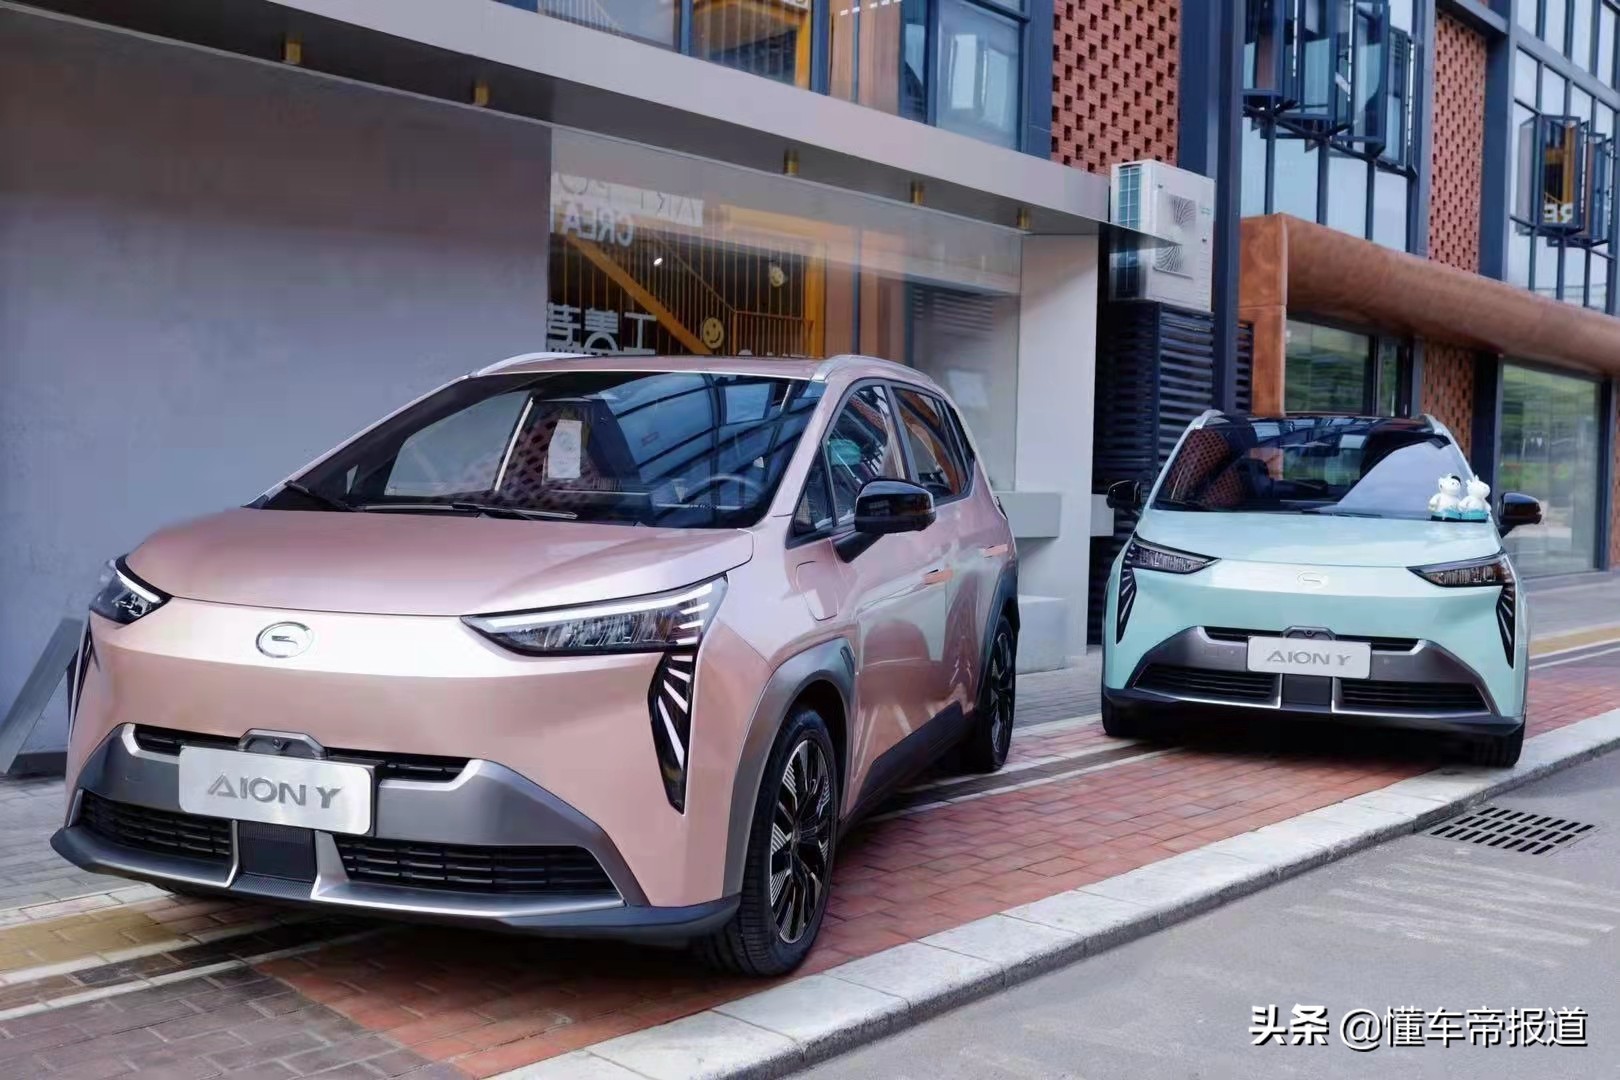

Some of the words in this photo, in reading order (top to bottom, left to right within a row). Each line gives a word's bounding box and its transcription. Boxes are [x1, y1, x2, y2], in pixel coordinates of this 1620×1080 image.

[1267, 650, 1330, 665] AION
[1336, 654, 1351, 666] Y
[207, 773, 306, 806] AION
[316, 786, 342, 809] Y
